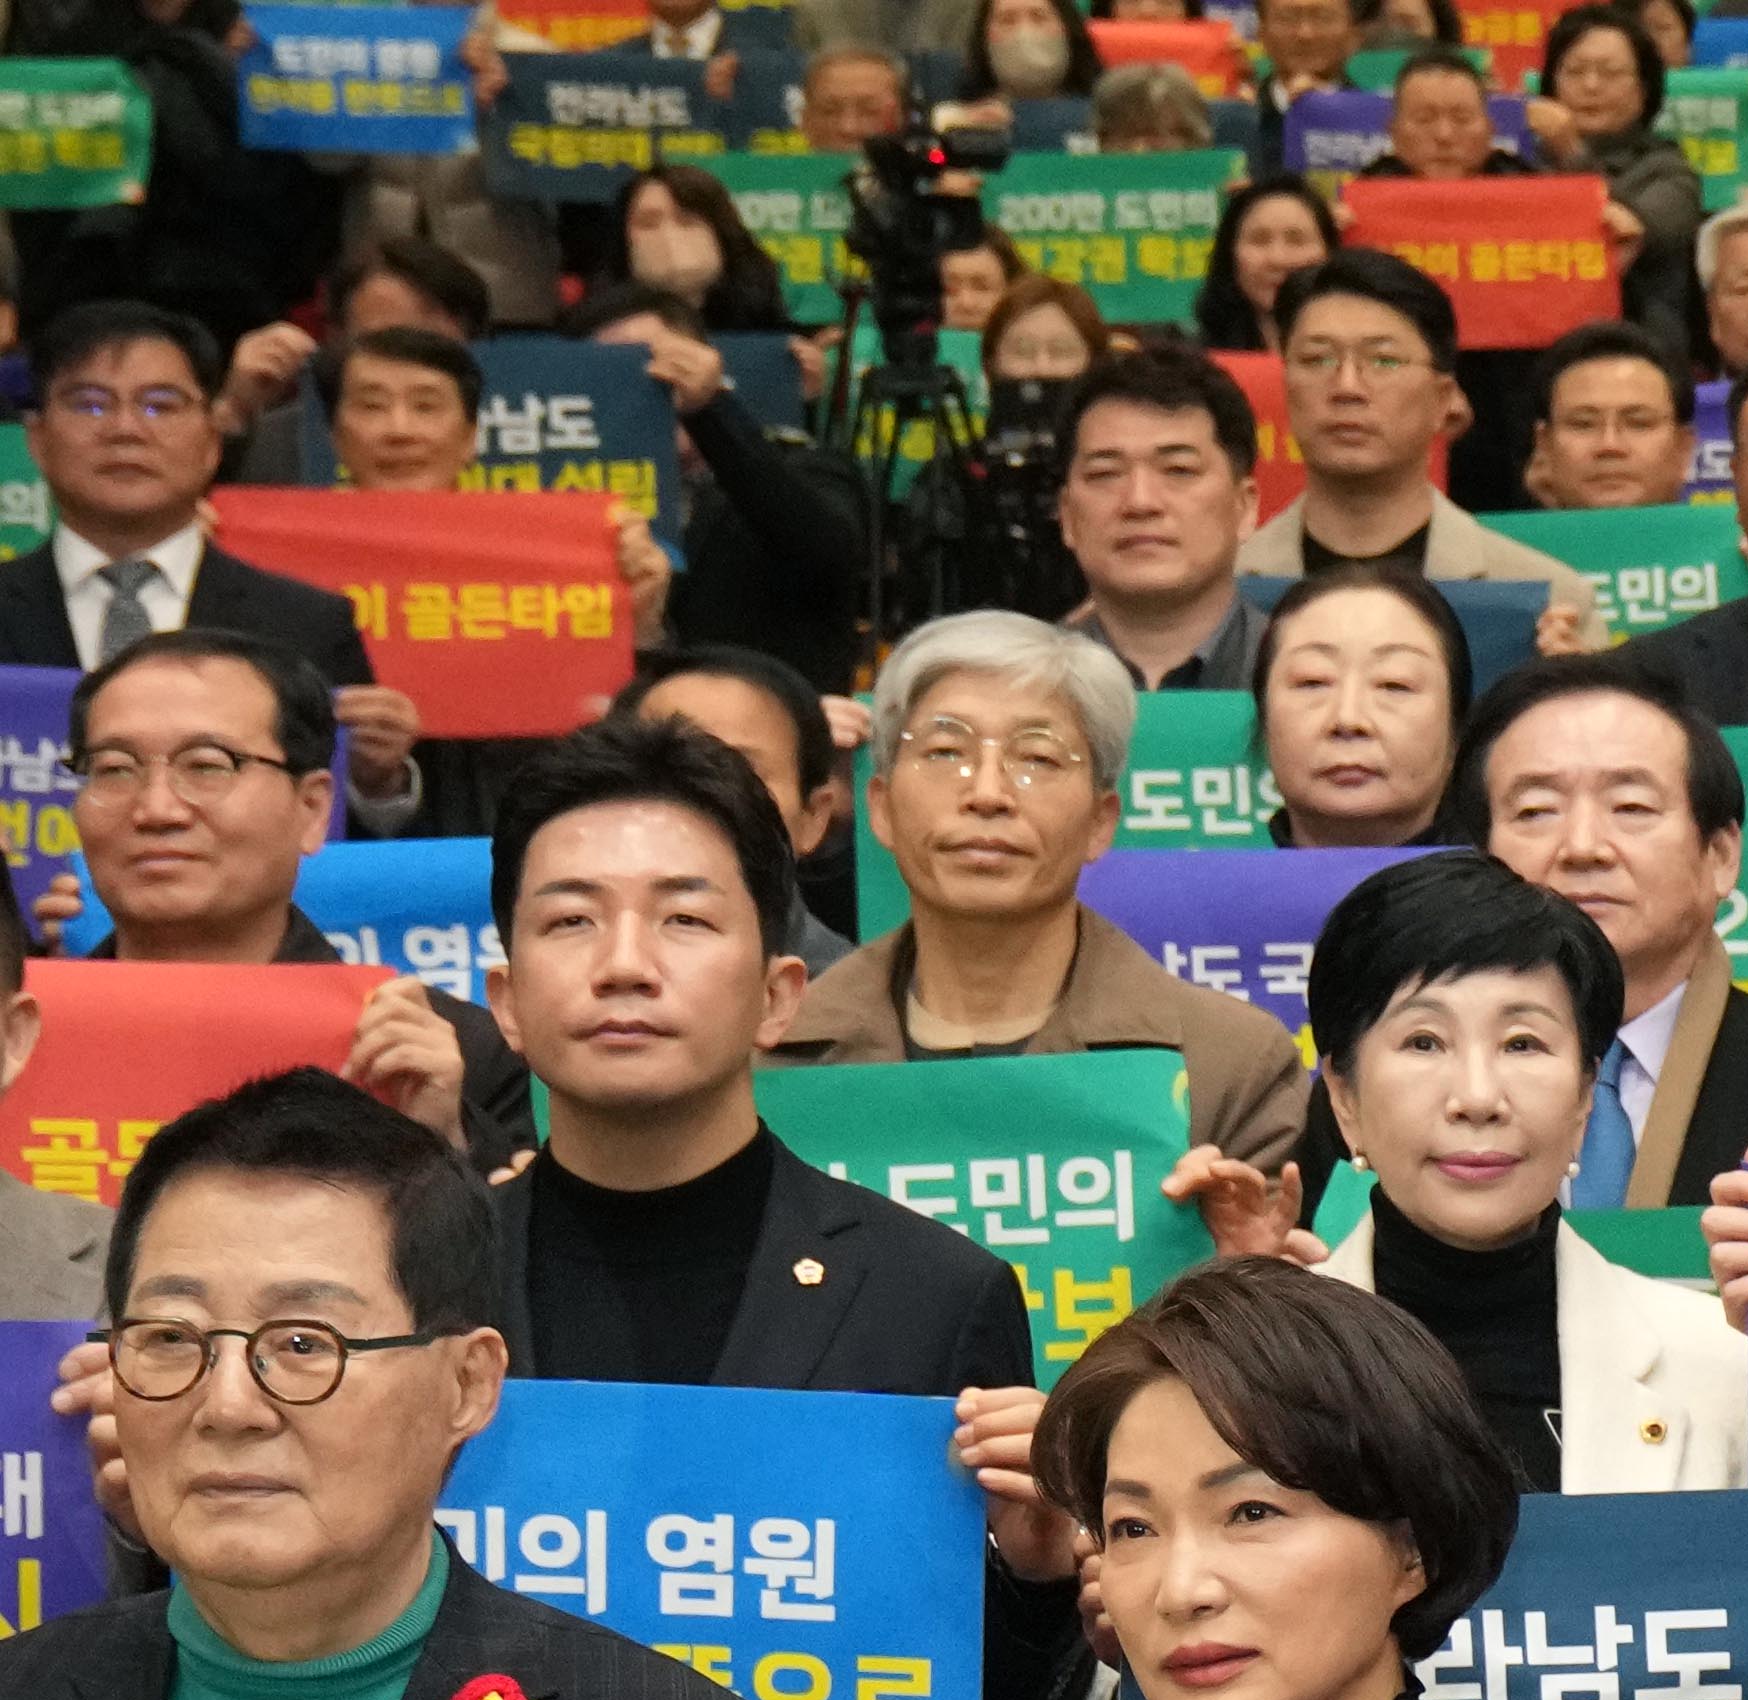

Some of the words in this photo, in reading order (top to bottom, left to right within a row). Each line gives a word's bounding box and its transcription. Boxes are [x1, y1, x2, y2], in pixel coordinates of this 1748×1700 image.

[999, 192, 1105, 232] 200만
[1469, 240, 1607, 282] 골든타임
[478, 395, 598, 453] 남도
[406, 583, 612, 641] 골든타임
[889, 1150, 1134, 1244] 도민의
[1022, 1265, 1135, 1359] 보
[645, 1511, 836, 1622] 염원
